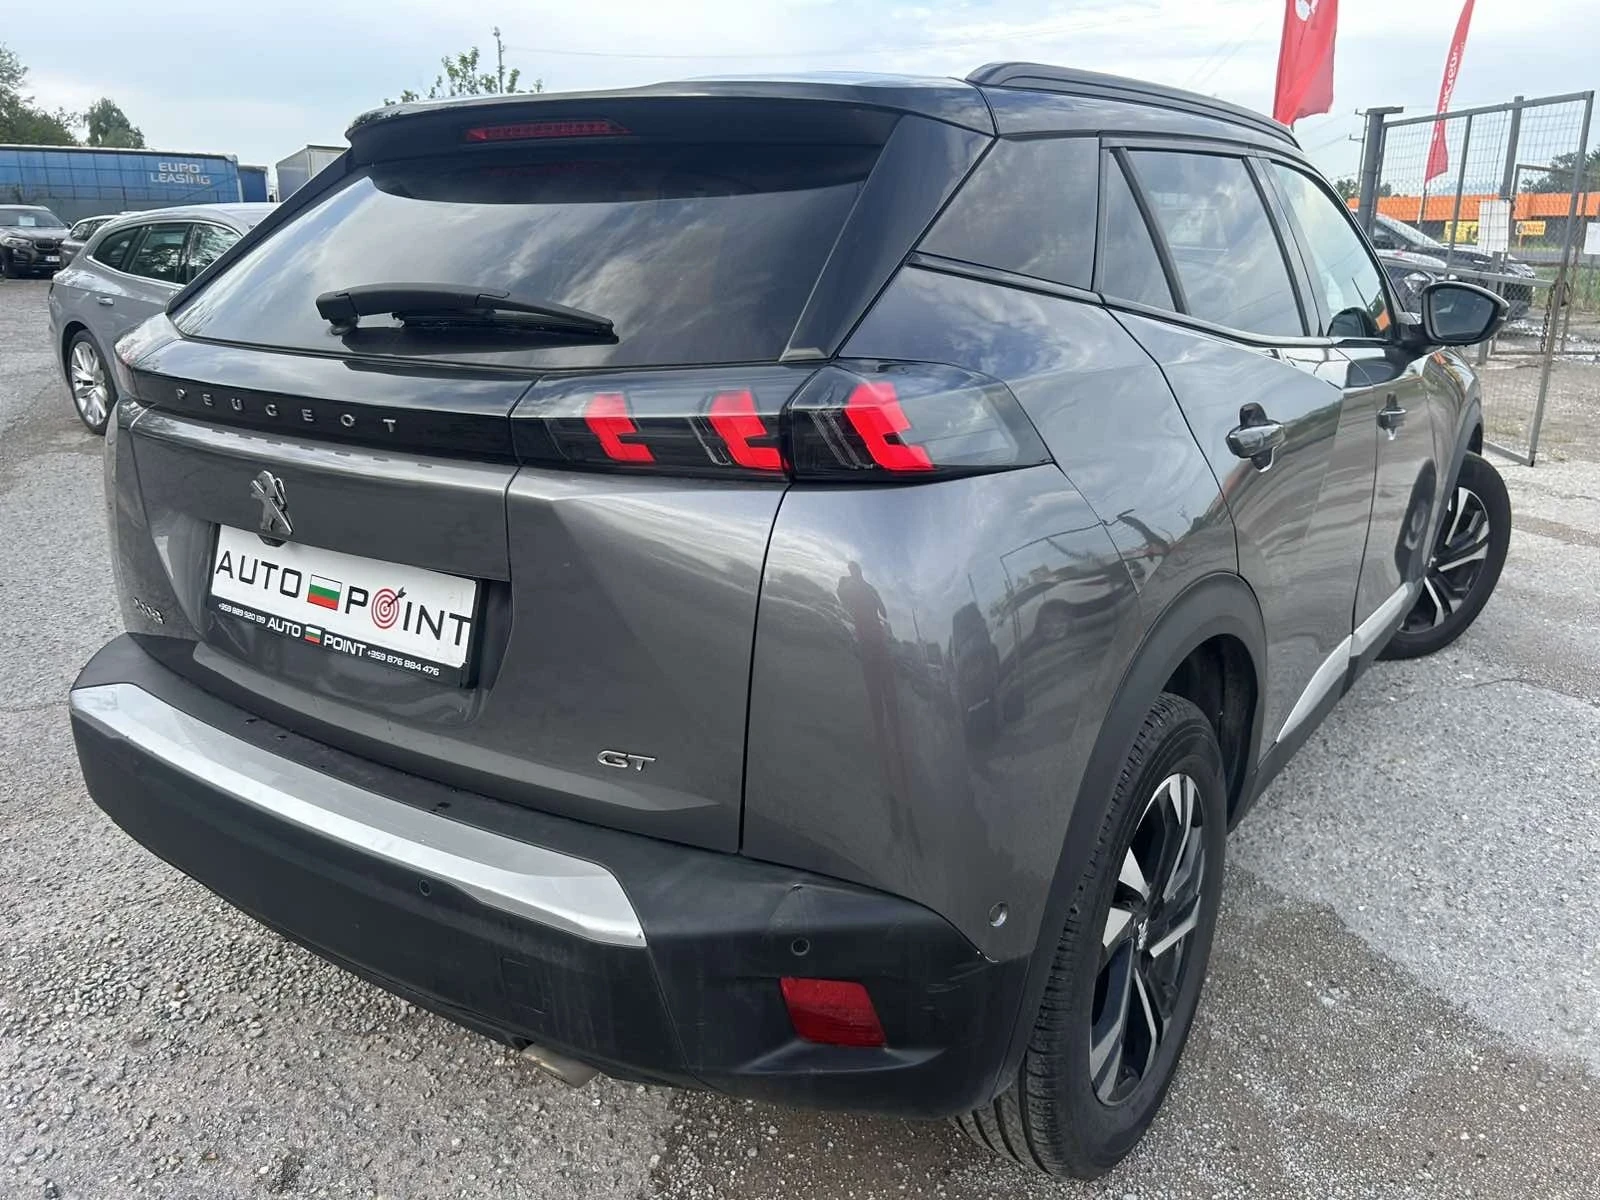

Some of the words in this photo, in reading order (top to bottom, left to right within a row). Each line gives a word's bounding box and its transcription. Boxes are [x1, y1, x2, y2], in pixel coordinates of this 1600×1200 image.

[150, 171, 211, 185] LEASING
[175, 387, 397, 433] PEUGEOT
[215, 550, 303, 599] AUTO
[266, 616, 302, 638] AUTO
[323, 633, 367, 657] POINT
[366, 650, 386, 661] +359
[386, 654, 404, 666] 876
[403, 659, 422, 672] 884
[422, 665, 440, 676] 476
[597, 749, 657, 771] GT
